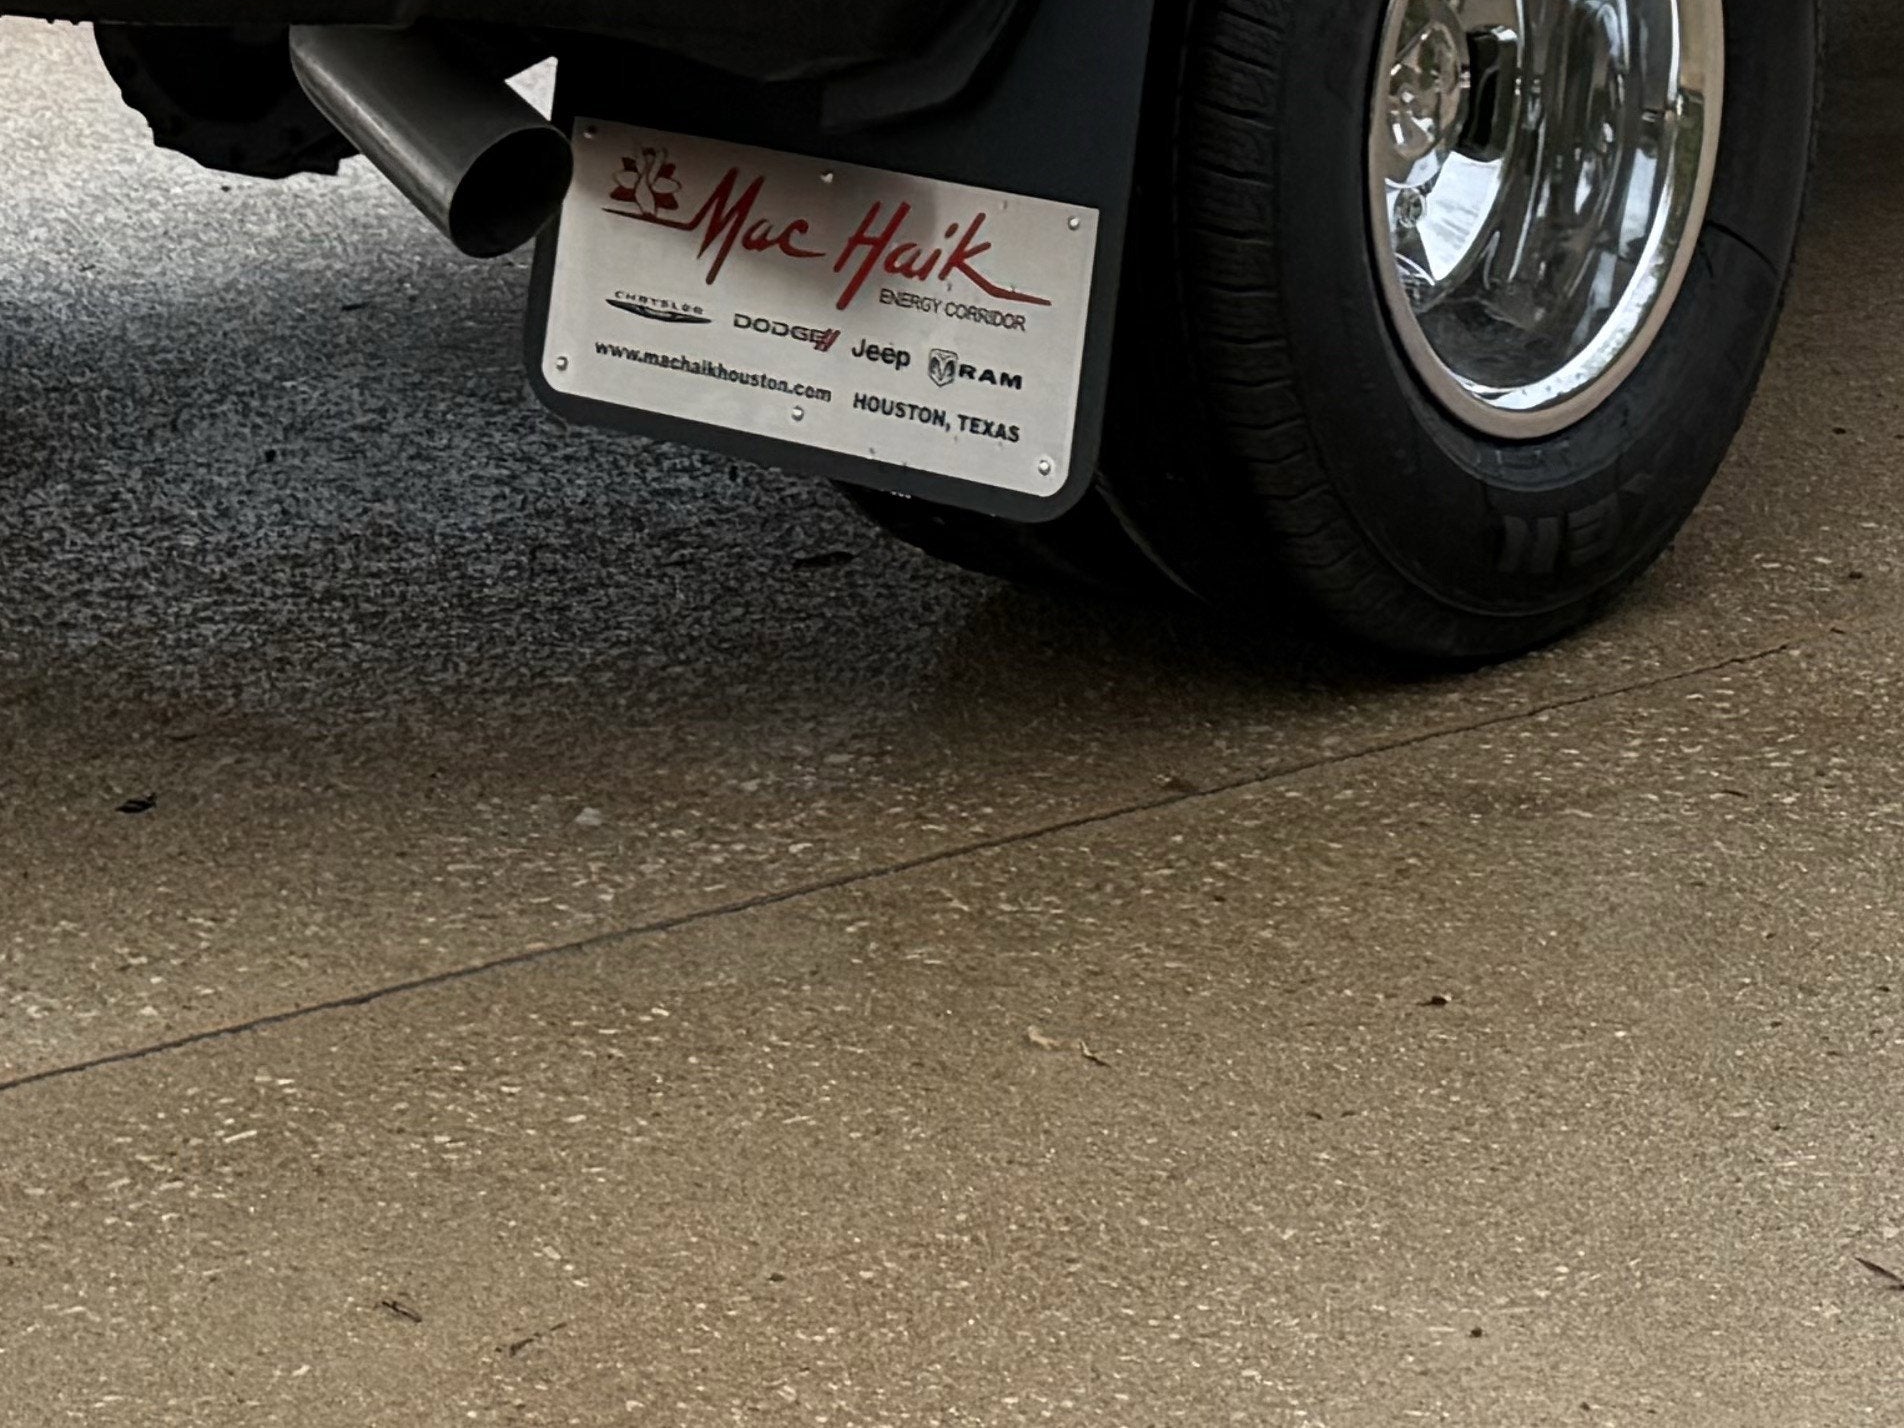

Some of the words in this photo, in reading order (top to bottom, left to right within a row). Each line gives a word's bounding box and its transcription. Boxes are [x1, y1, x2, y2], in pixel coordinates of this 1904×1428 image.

[686, 166, 826, 285] Mac
[833, 200, 1051, 311] Haik
[733, 313, 827, 344] DODGE
[851, 339, 912, 371] Jeep
[958, 363, 1024, 390] RAM
[879, 288, 942, 314] ENERGY
[944, 302, 1027, 332] CORRIDOR
[595, 341, 833, 403] www.machaikhouston.com
[852, 392, 951, 432] HOUSTON,
[957, 413, 1021, 443] TEXAS
